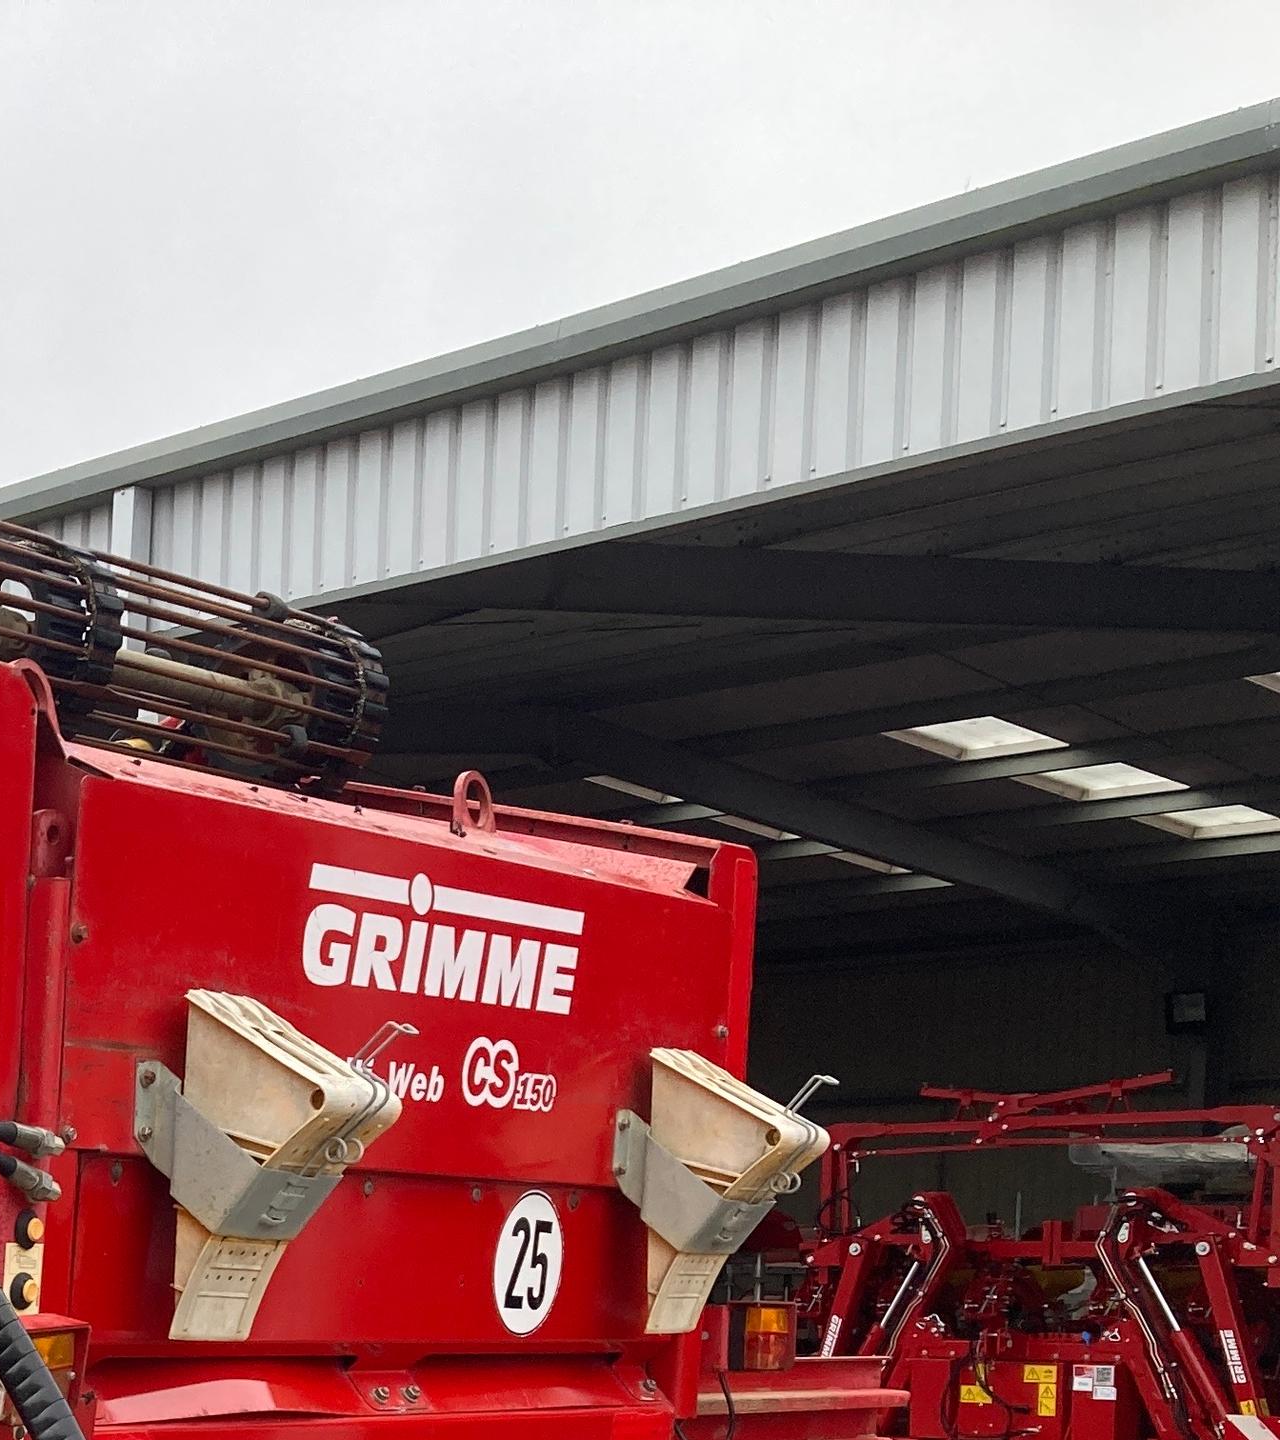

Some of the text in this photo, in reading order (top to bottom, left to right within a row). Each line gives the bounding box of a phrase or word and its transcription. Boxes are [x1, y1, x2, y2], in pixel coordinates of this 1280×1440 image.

[303, 873, 579, 1015] GRIMME
[504, 1217, 553, 1310] 25
[821, 1315, 839, 1358] GRIMM
[1222, 1330, 1247, 1383] GRIMME
